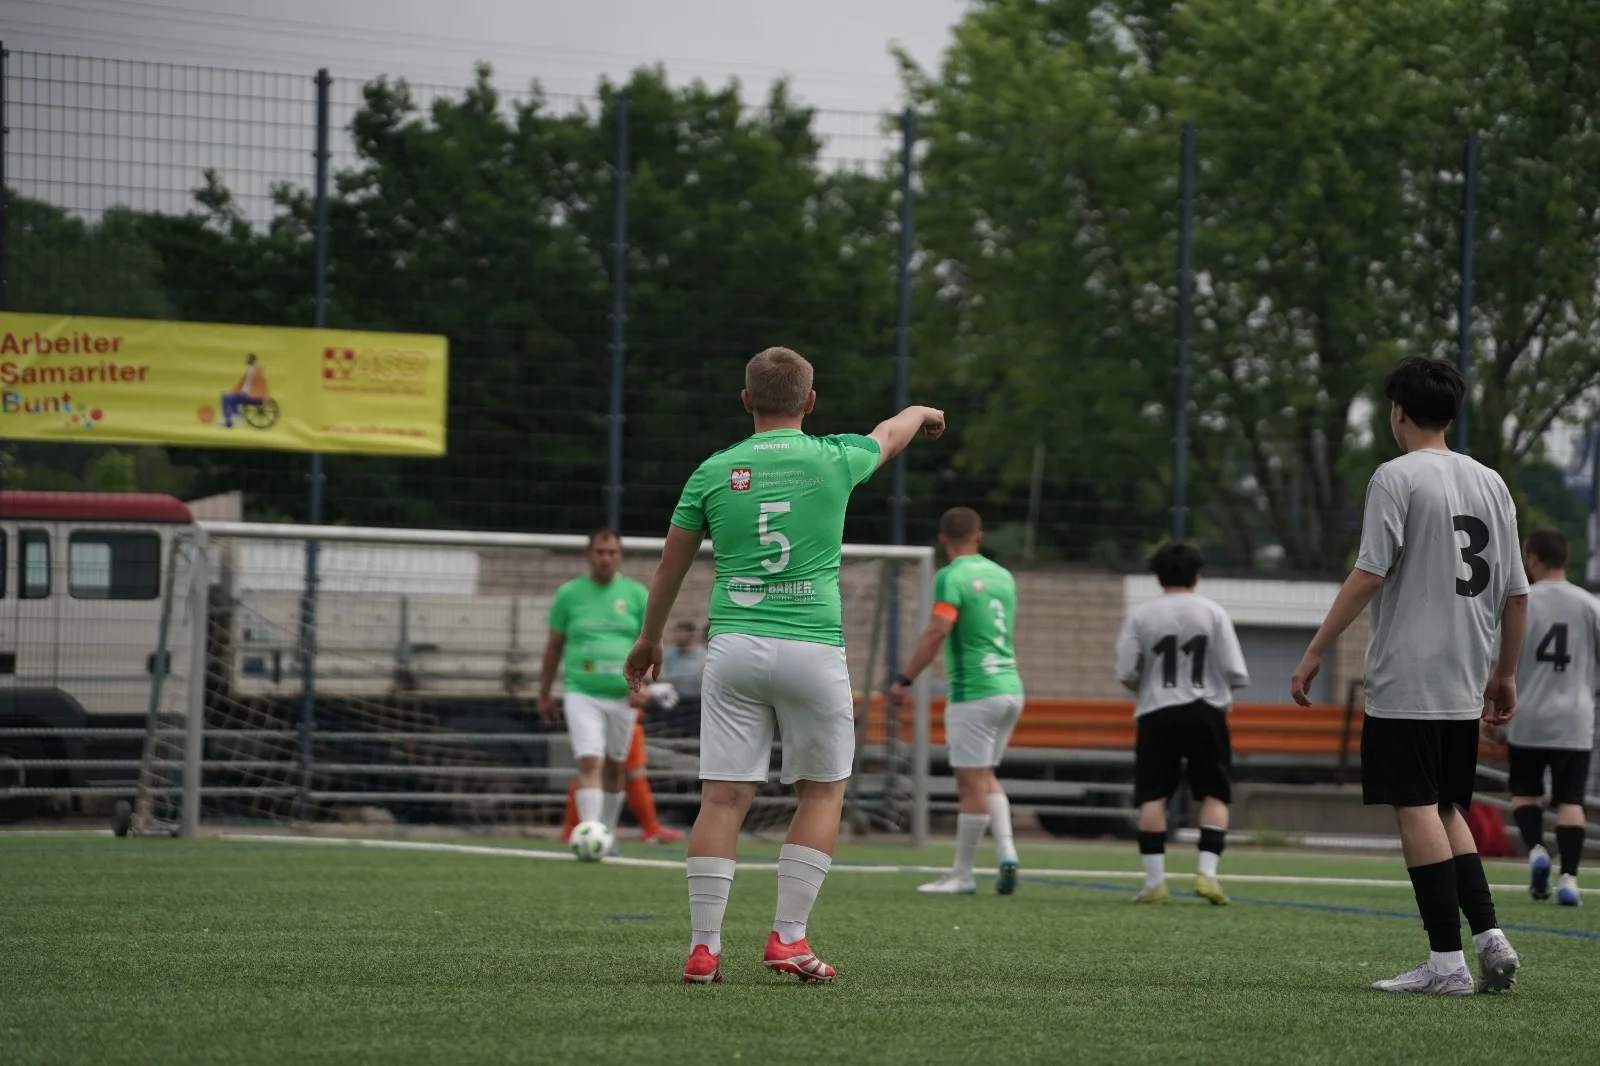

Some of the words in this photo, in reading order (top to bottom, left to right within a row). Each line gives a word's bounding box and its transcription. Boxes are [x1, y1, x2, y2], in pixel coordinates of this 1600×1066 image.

[1, 332, 122, 354] Arbeiter
[0, 361, 149, 384] Samariter
[2, 391, 72, 413] Bunt
[758, 501, 791, 573] 5
[1452, 514, 1491, 598] 3
[1152, 634, 1208, 689] 11
[1536, 622, 1571, 672] 4
